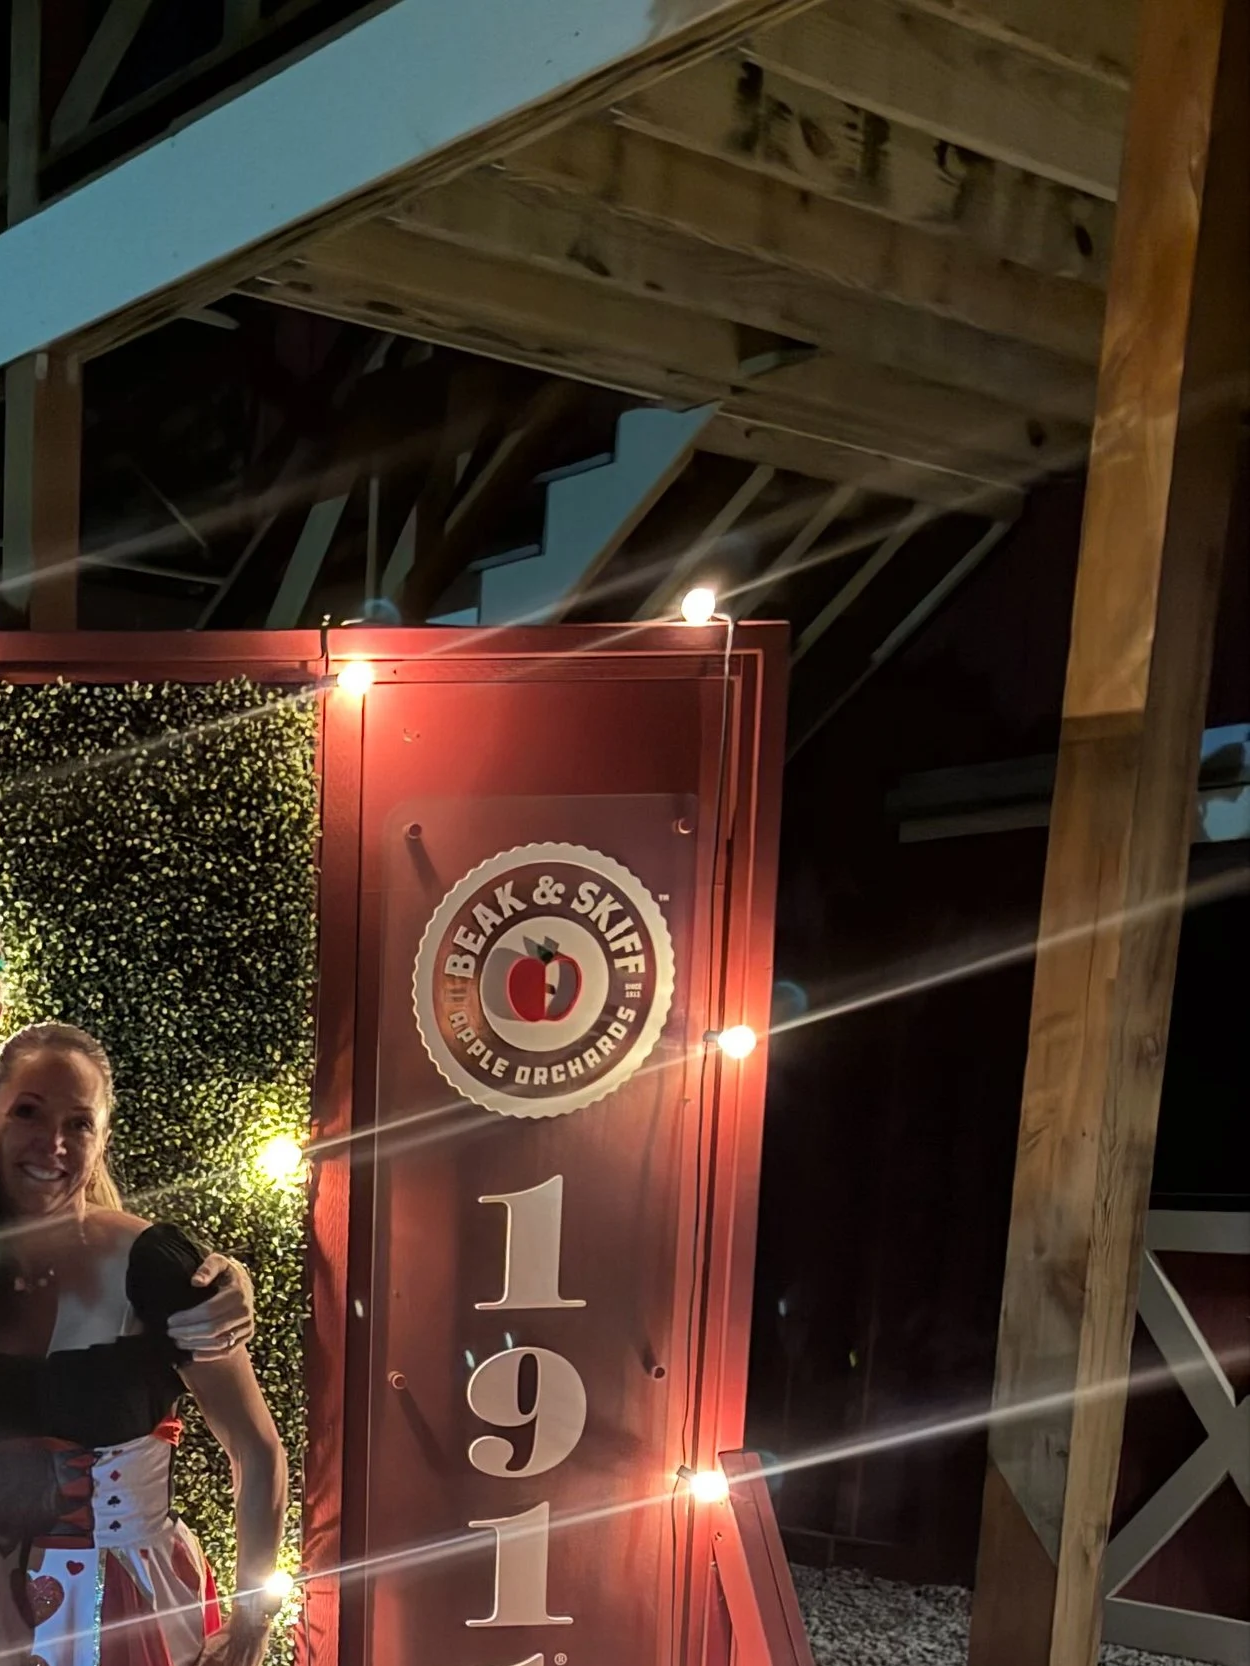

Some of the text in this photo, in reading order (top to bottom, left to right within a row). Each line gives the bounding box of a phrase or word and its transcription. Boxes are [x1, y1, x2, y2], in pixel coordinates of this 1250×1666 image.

[444, 875, 646, 979] BEAK & SKIFF
[449, 1005, 637, 1085] APPLE ORCHARDS
